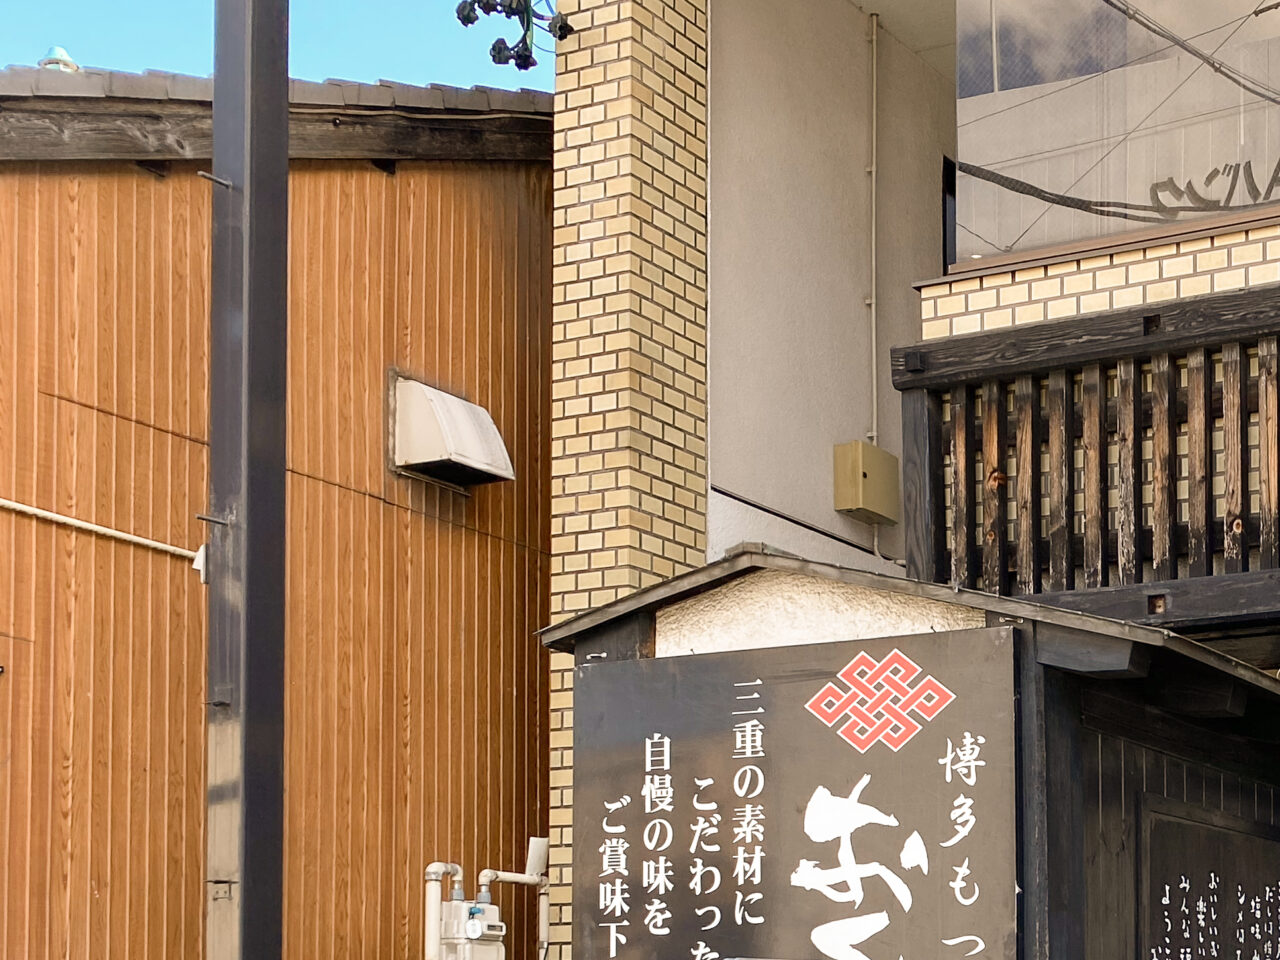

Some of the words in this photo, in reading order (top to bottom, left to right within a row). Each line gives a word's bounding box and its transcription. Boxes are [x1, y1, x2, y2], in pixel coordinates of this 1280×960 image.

[641, 732, 675, 937] 自慢の味を
[731, 677, 767, 926] 三重の素材に
